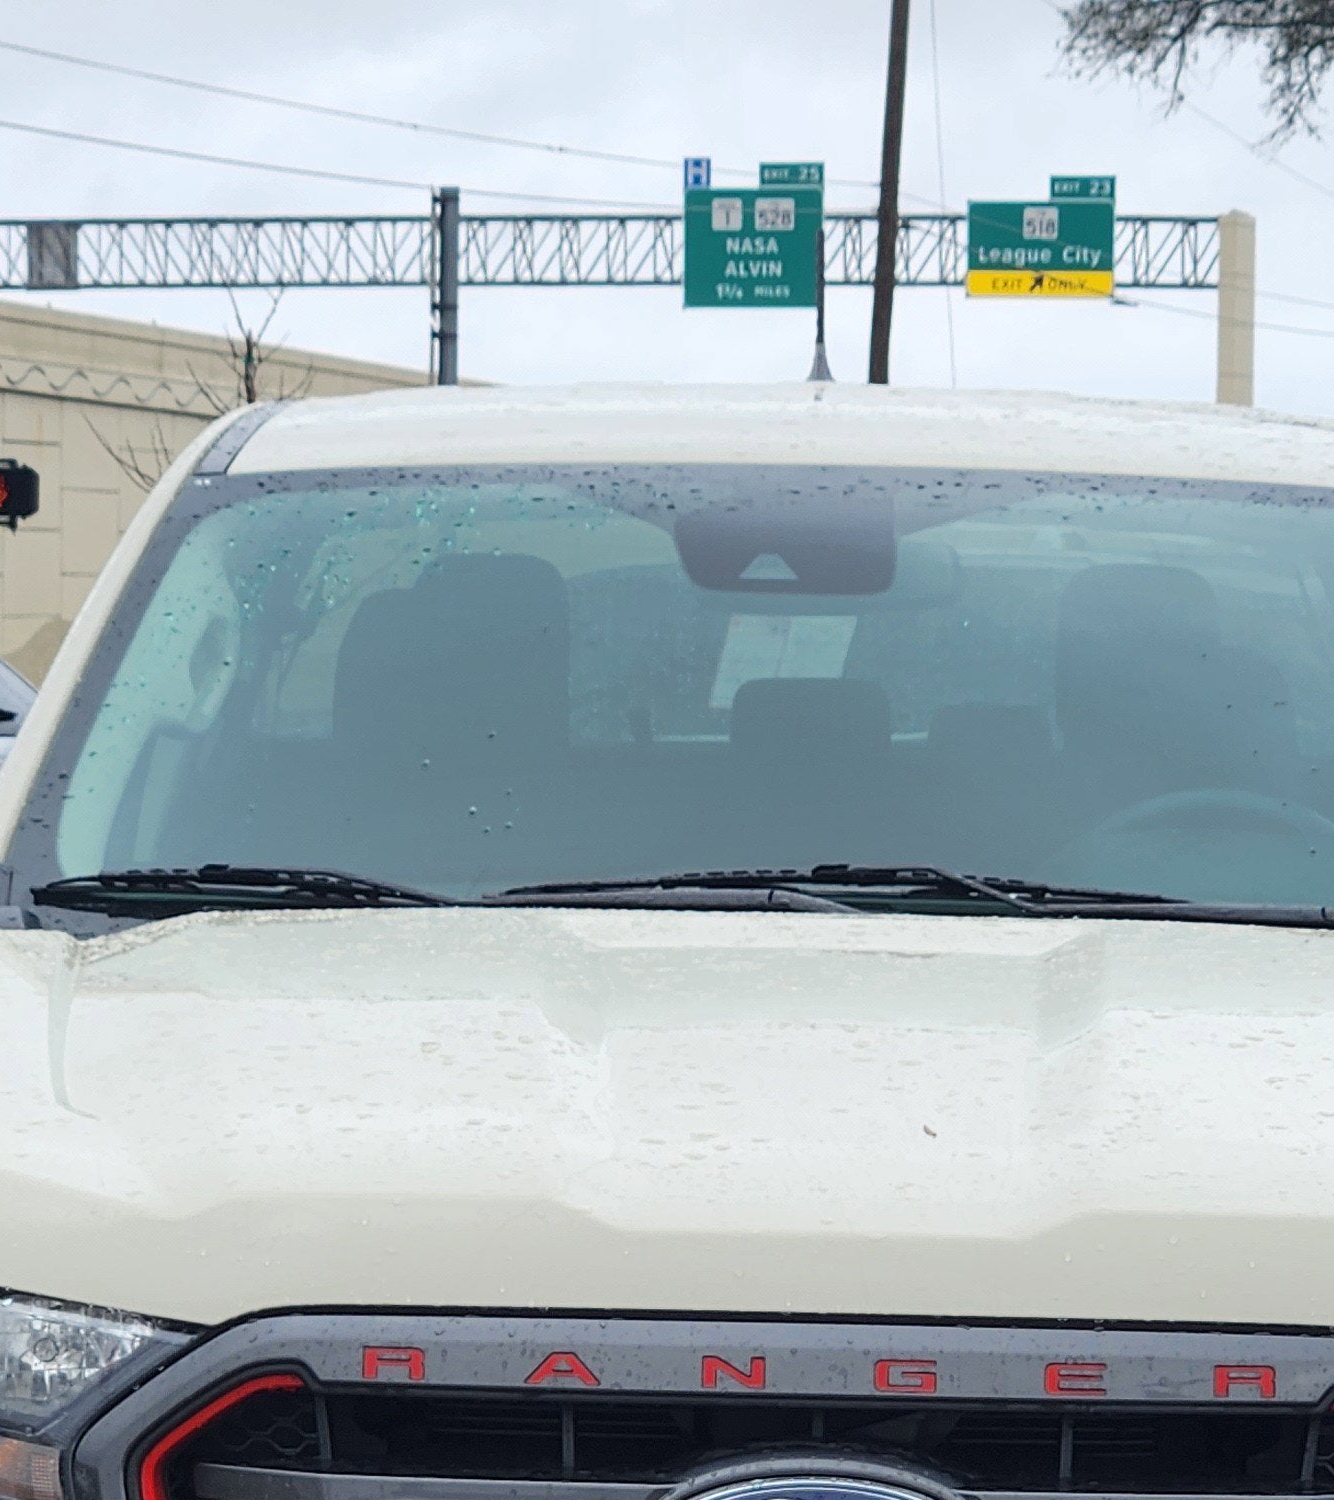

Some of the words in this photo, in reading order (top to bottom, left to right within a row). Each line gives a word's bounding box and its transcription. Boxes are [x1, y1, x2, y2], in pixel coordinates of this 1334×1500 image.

[764, 168, 789, 180] EXIT
[1054, 180, 1080, 193] EXIT
[726, 236, 779, 255] NASA
[978, 246, 1052, 268] League
[1062, 245, 1102, 268] City
[725, 260, 783, 278] ALVIN
[754, 284, 791, 299] MILES
[991, 278, 1023, 289] EXIT
[361, 1344, 1278, 1398] RANGER
